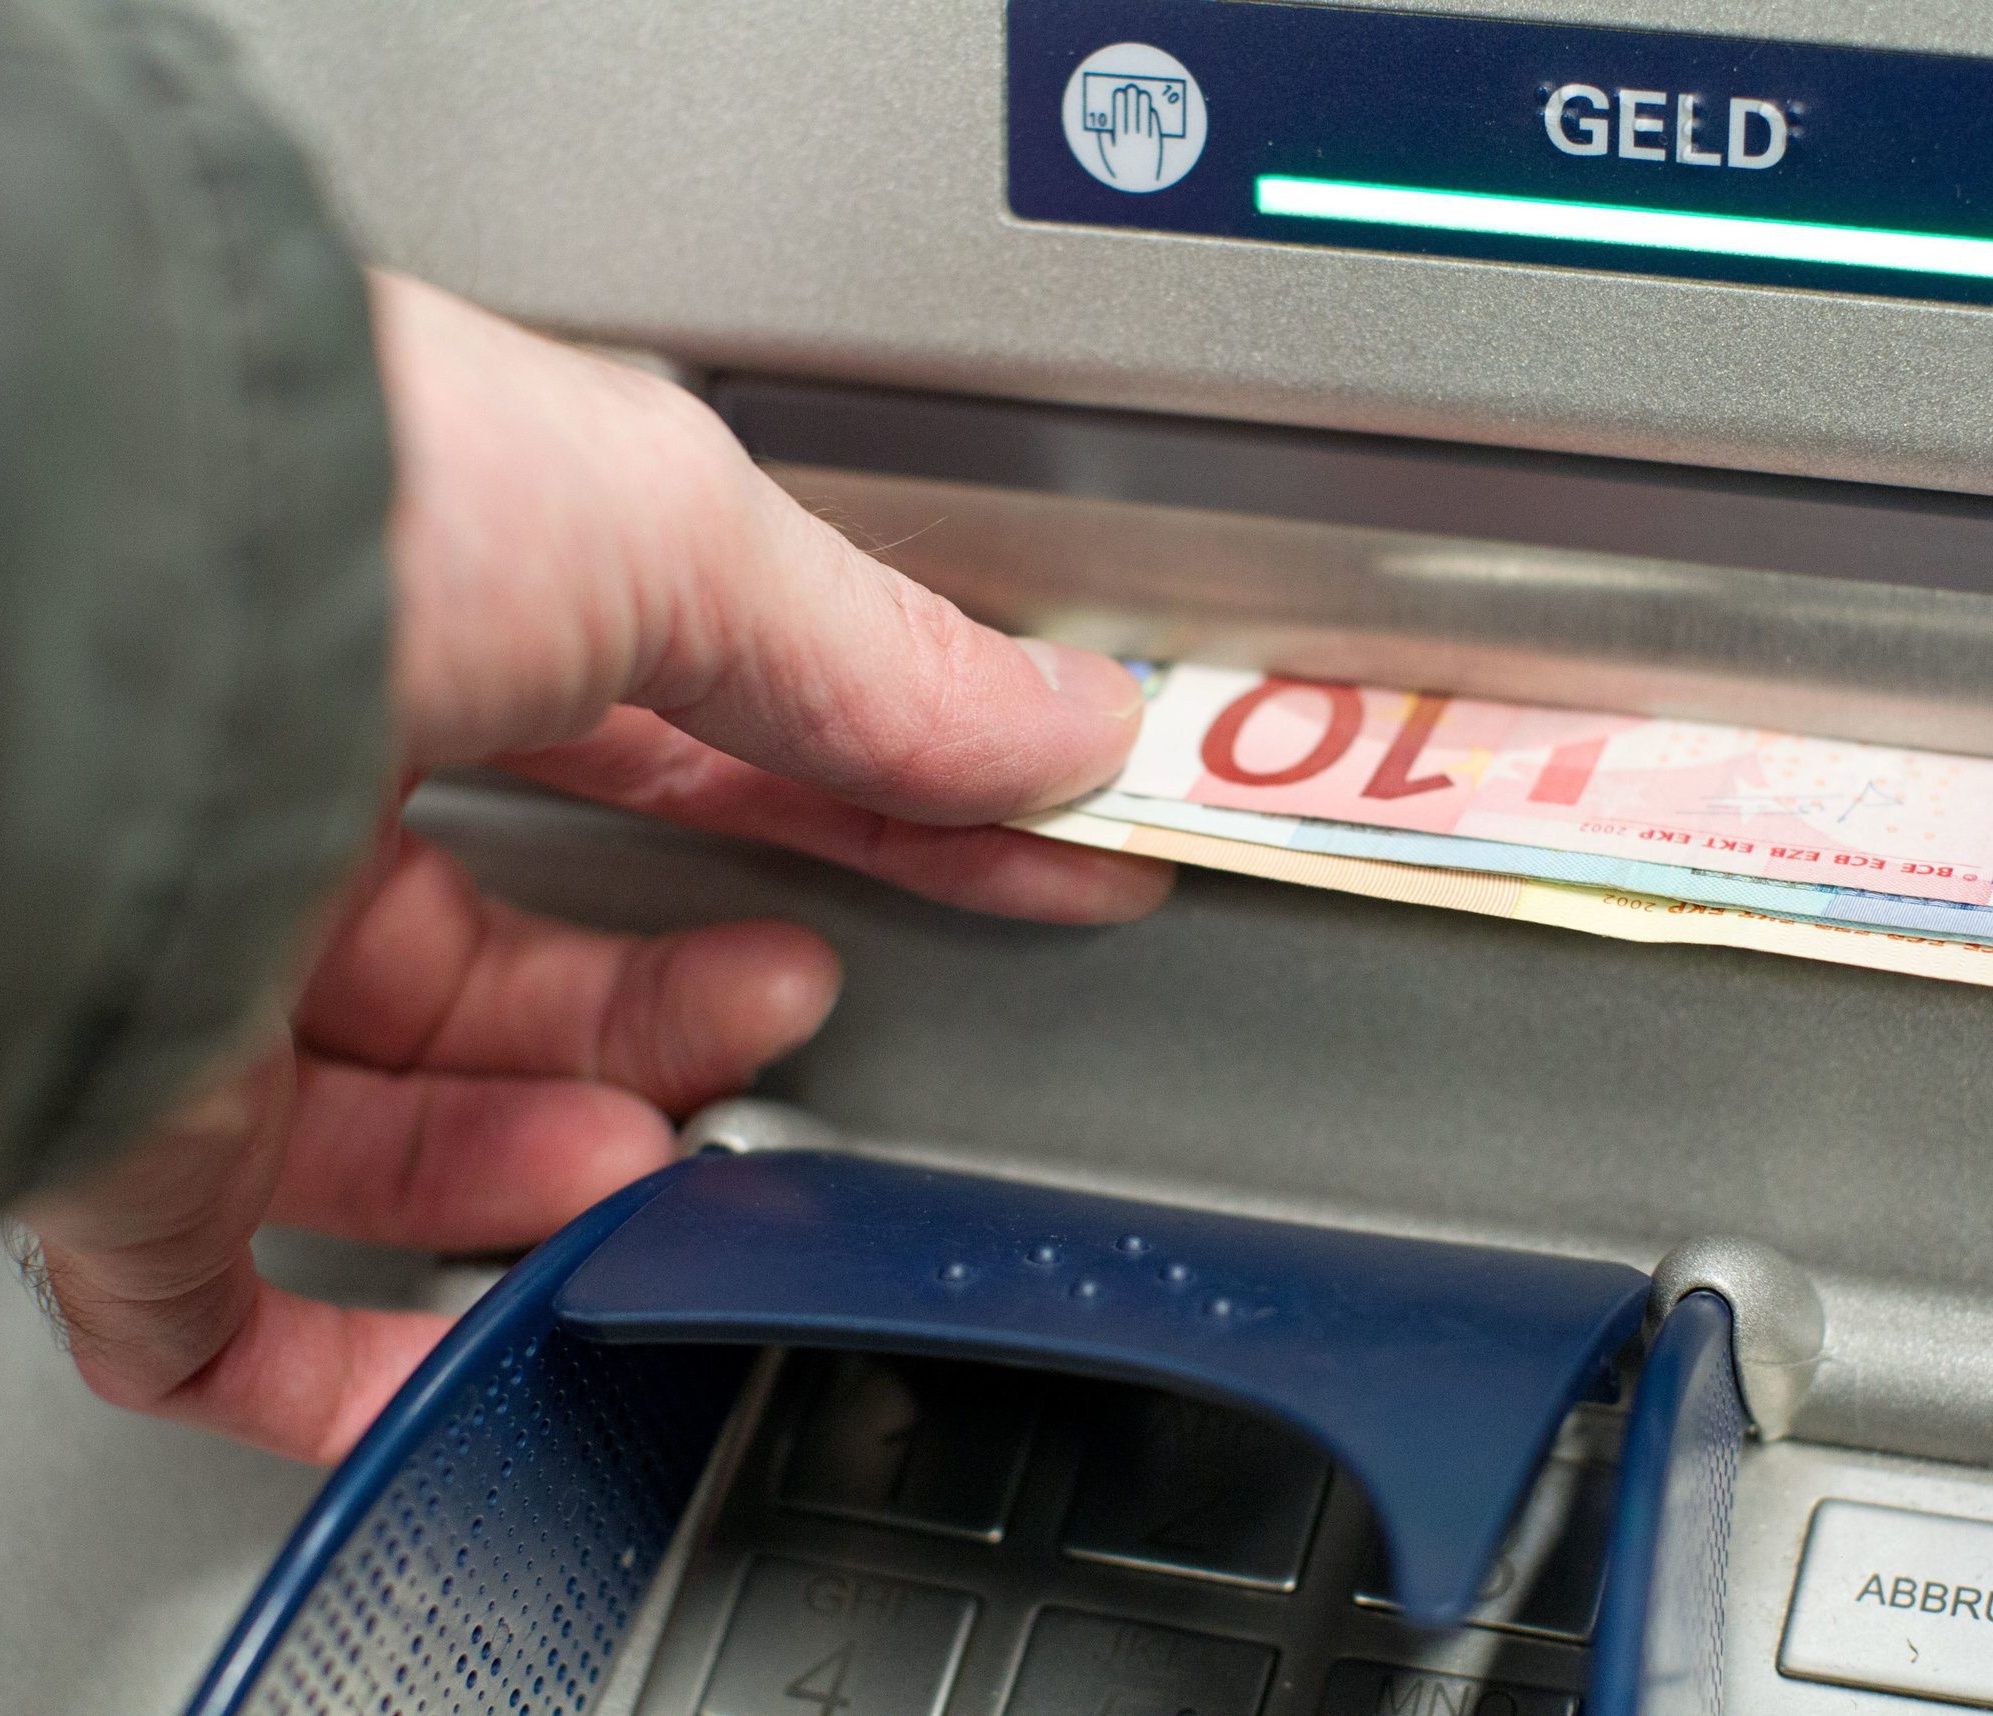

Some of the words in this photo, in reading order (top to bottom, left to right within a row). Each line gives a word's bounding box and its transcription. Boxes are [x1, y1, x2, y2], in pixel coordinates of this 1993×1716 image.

[1162, 85, 1180, 104] 10
[1089, 112, 1107, 127] 10
[1545, 84, 1787, 169] GELD
[1201, 671, 1454, 800] 10
[1579, 822, 1627, 836] 2002
[1639, 829, 1691, 845] EKP
[1704, 838, 1754, 854] EKT
[1770, 847, 1820, 862] EZB
[1834, 854, 1887, 870] ECB
[1901, 863, 1954, 877] BCE
[1603, 894, 1656, 912] 2002
[784, 1640, 857, 1716] 4
